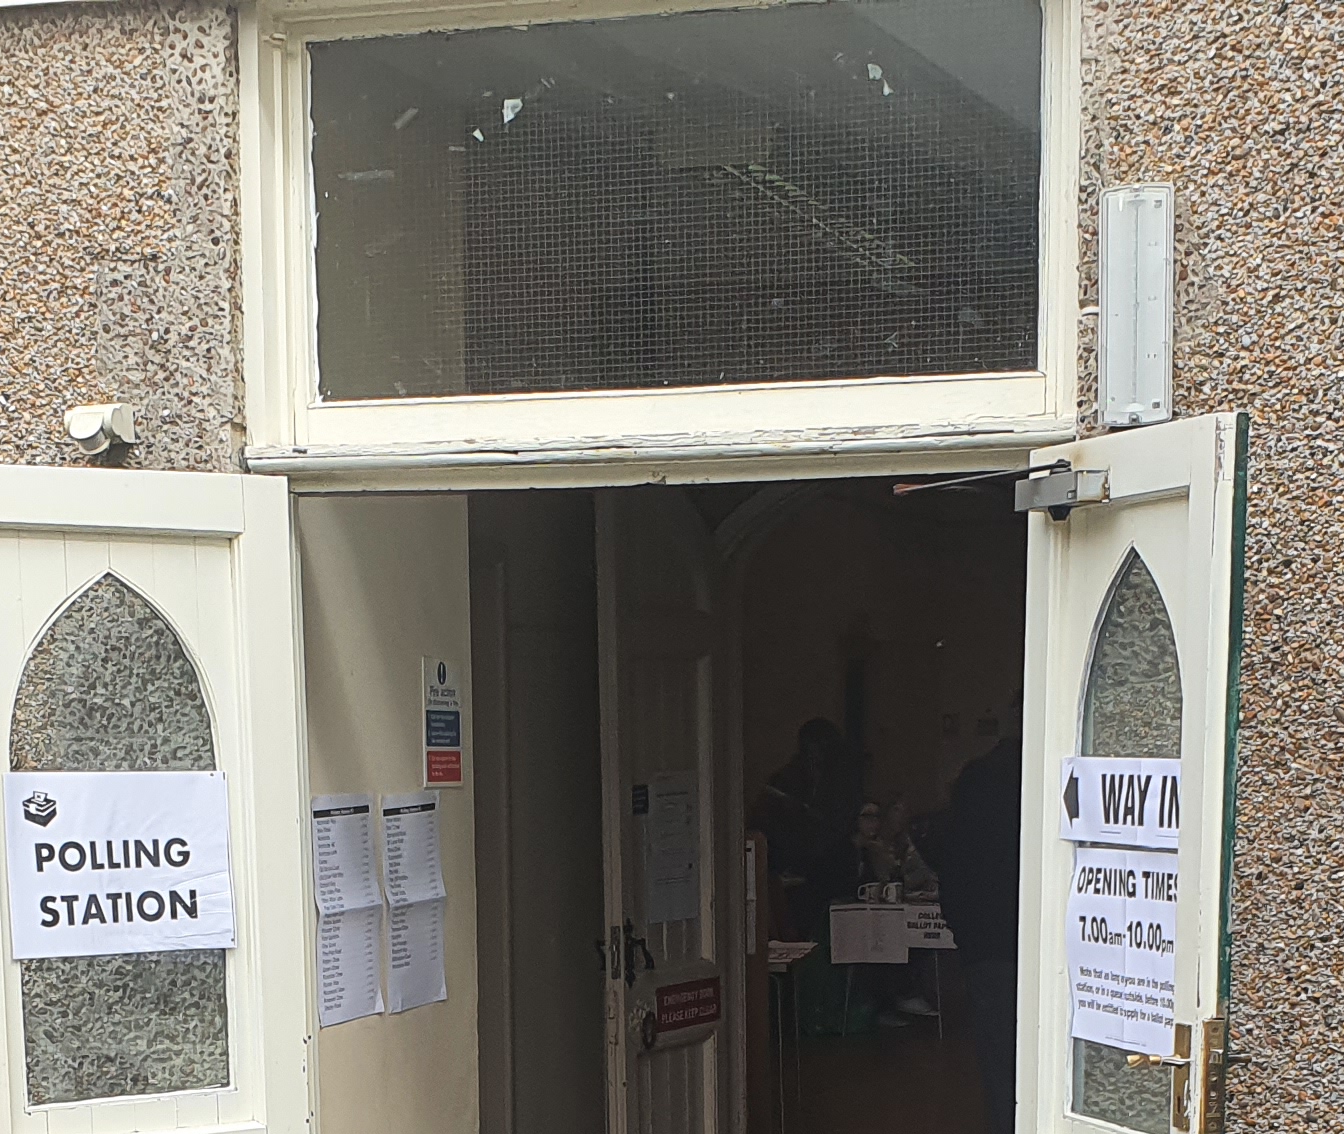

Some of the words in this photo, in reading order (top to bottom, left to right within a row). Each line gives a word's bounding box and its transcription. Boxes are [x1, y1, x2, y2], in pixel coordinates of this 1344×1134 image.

[1101, 773, 1152, 827] WAY
[1159, 775, 1179, 829] IN
[34, 837, 191, 873] POLLING
[1077, 866, 1137, 899] OPENING
[39, 889, 198, 928] STATION
